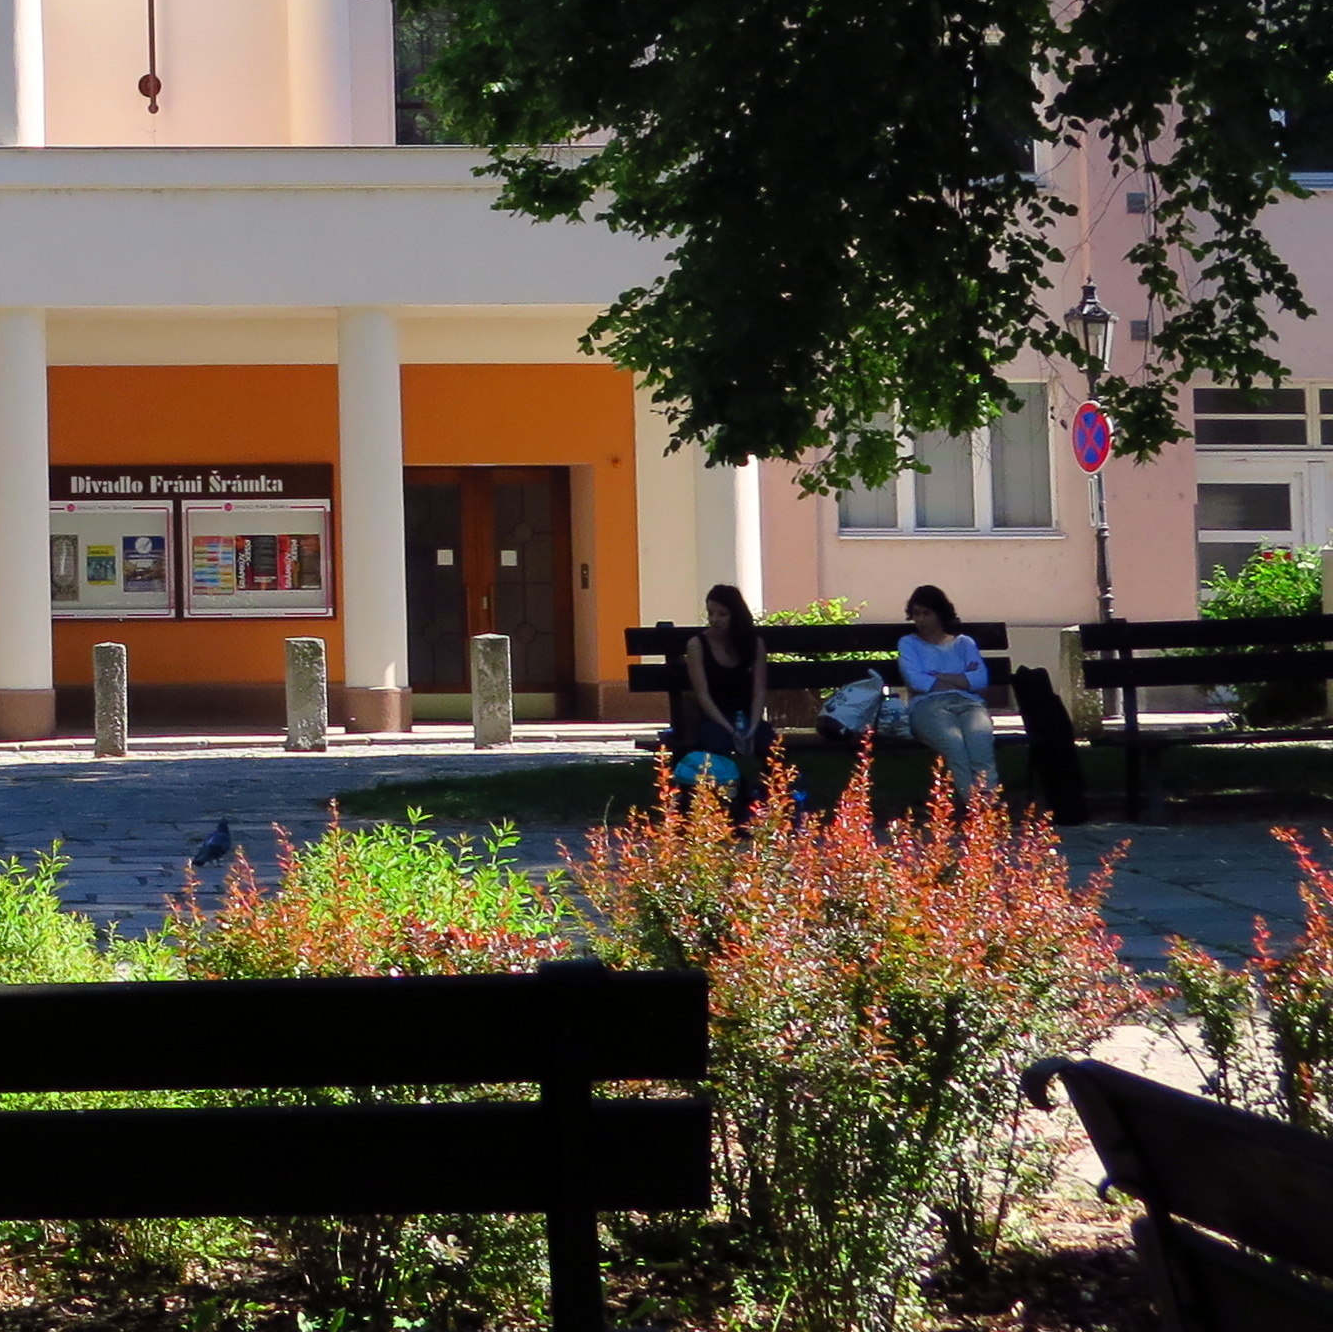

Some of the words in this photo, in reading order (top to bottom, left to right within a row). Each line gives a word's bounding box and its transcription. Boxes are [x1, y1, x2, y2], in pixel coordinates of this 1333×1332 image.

[70, 475, 144, 494] Divadlo
[149, 475, 203, 493] Fráni
[208, 470, 283, 493] Šrámka
